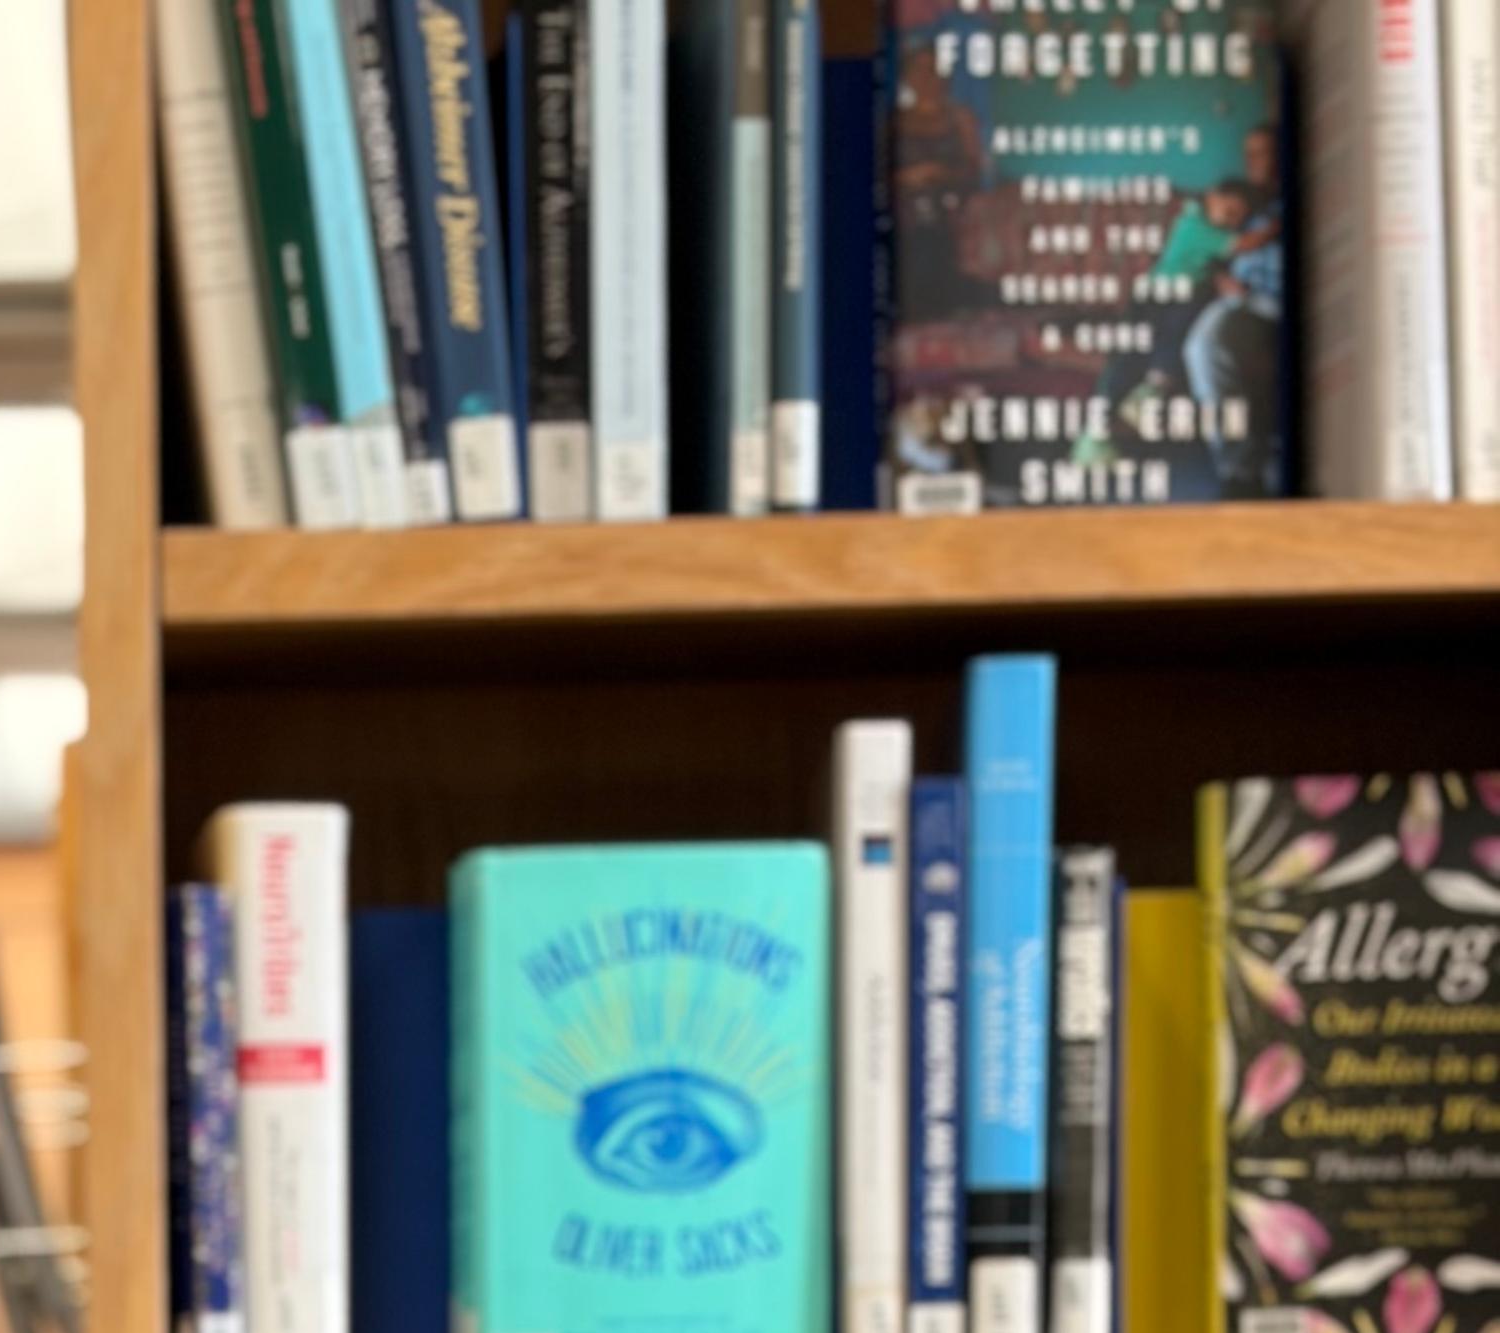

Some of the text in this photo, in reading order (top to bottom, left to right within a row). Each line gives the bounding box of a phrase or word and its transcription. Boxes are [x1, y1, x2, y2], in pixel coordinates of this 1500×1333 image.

[934, 33, 1254, 77] FORGETTING
[992, 127, 1201, 154] ALZHEIMER'S
[1021, 176, 1172, 203] FAMILIES
[1029, 226, 1163, 253] AND THE
[436, 194, 487, 332] Disease
[1000, 275, 1194, 302] SEARCH FOR
[1041, 324, 1153, 352] A CURE
[941, 398, 1249, 441] JENNIE ERIN
[1019, 460, 1170, 503] SMITH
[523, 909, 801, 997] HALLUCINATIONS
[1283, 1097, 1433, 1146] Changing
[552, 1209, 783, 1280] OLIVER SACKS
